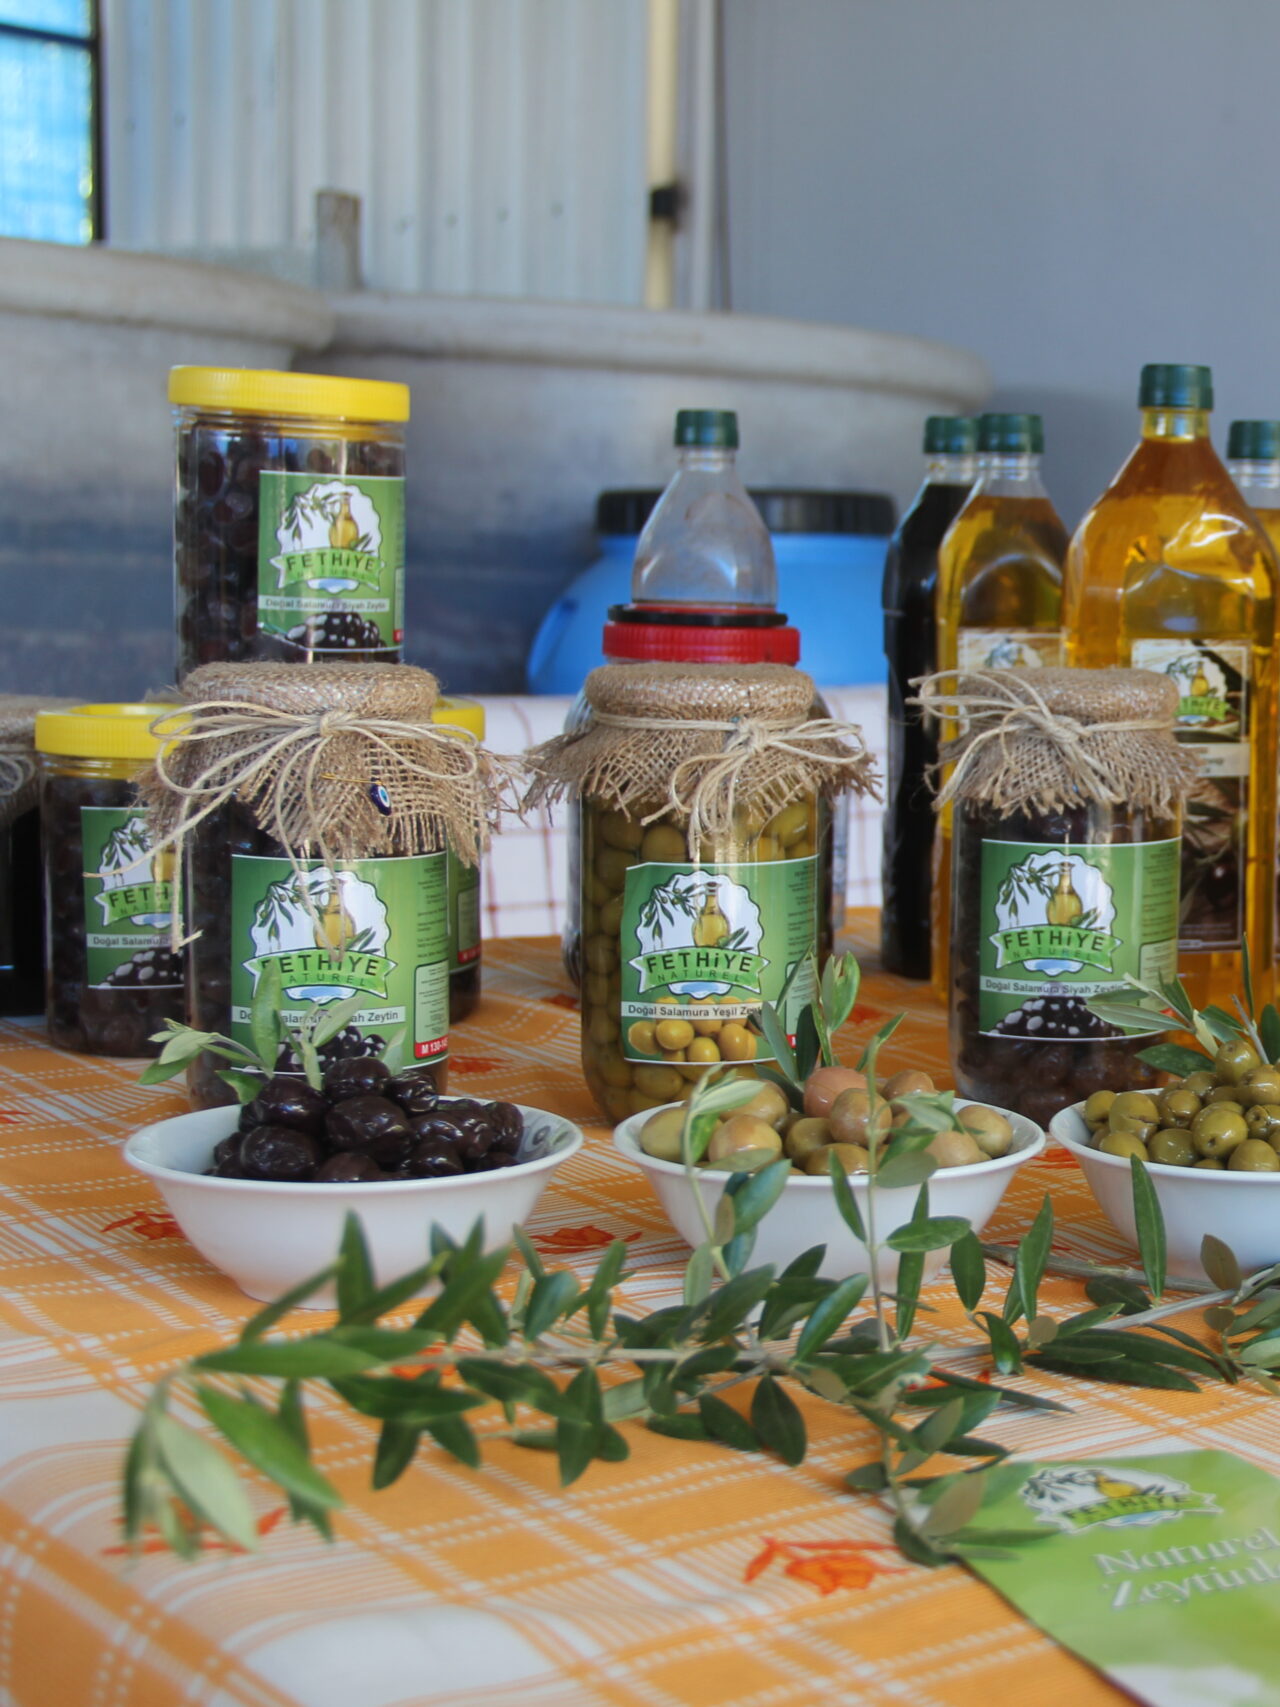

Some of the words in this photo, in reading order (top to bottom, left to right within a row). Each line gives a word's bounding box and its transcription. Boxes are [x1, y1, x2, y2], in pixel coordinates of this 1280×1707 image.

[109, 887, 169, 908] FETH
[93, 936, 119, 947] Doğal
[288, 972, 367, 988] ATUREL
[657, 969, 740, 983] NATUREL
[985, 979, 1010, 992] Doğal
[1062, 984, 1091, 996] Siyah
[367, 1010, 399, 1023] Zeytin
[627, 1004, 657, 1017] Doğal
[660, 1006, 709, 1017] Salamura
[713, 1006, 737, 1018] Yeşil
[421, 1043, 429, 1055] M
